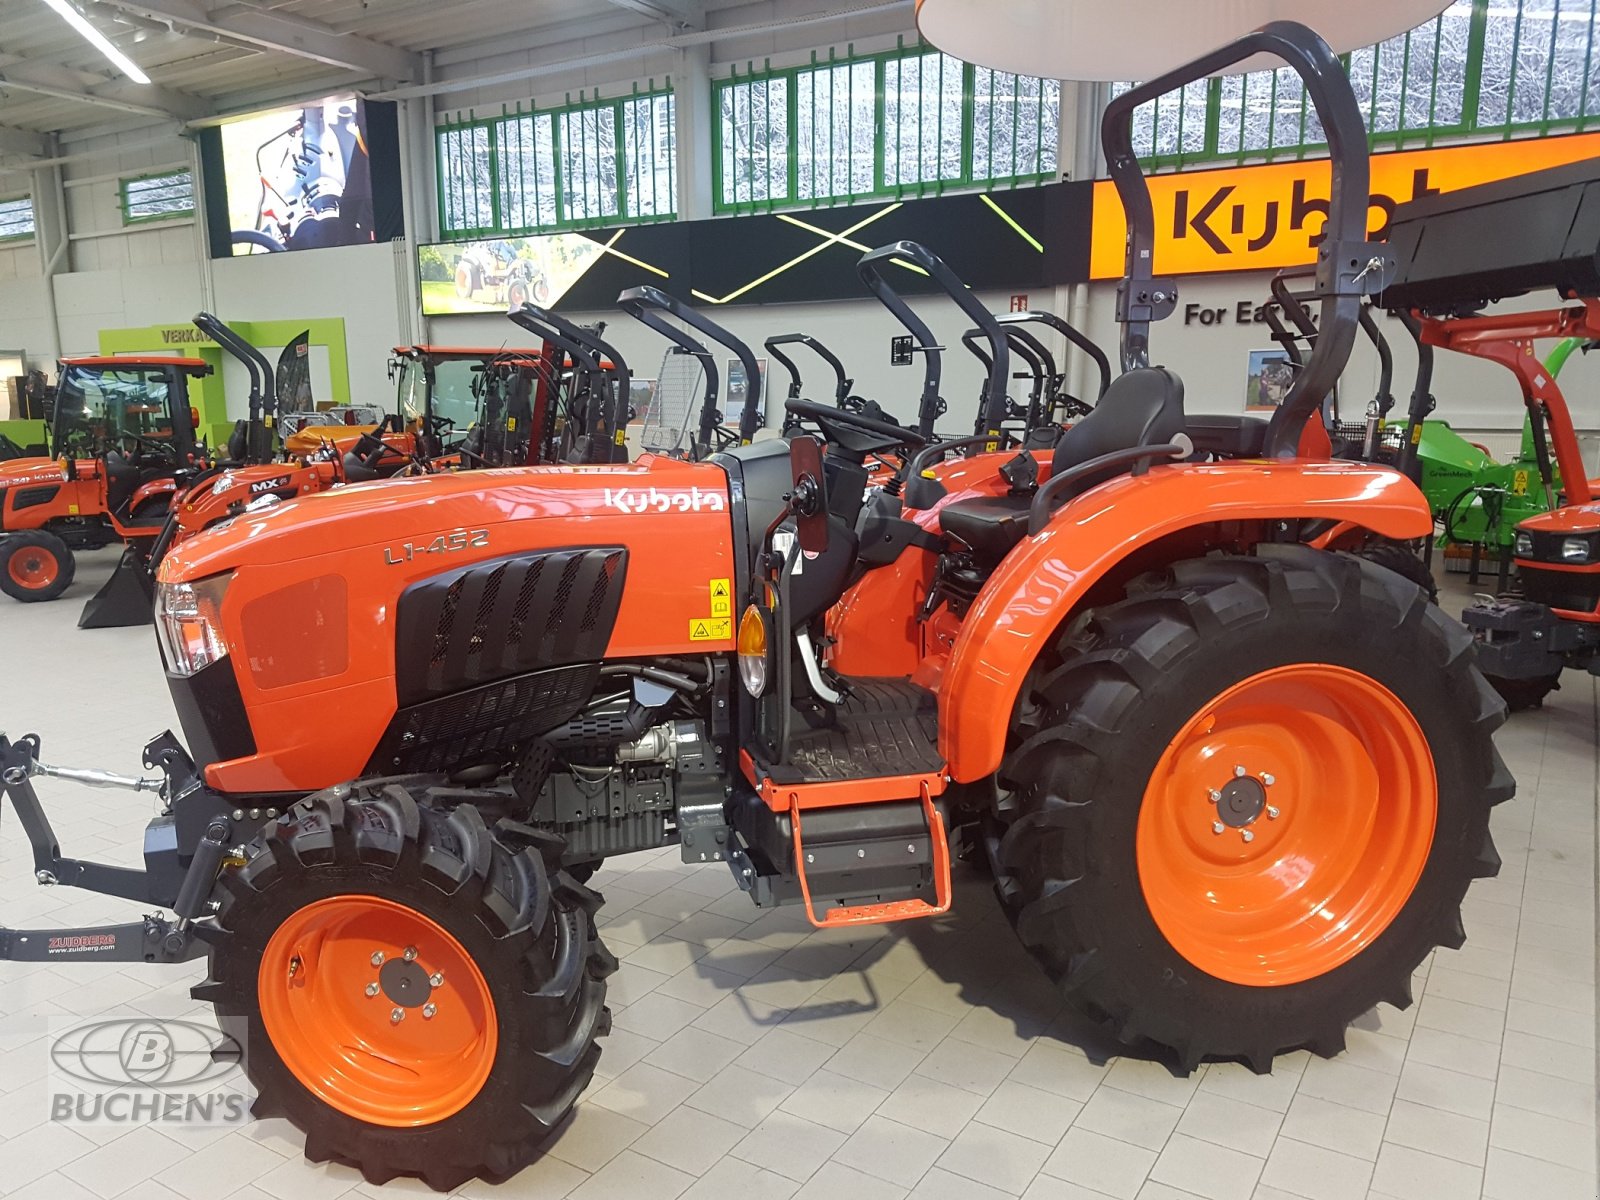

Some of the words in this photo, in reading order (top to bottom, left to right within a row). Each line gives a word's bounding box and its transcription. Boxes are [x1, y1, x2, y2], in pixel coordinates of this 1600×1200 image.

[1173, 168, 1440, 254] Kubot
[1184, 303, 1227, 325] For
[161, 329, 213, 343] VERKAU
[34, 472, 61, 480] Kubo
[251, 478, 279, 492] MX
[603, 486, 724, 513] Kubota
[384, 529, 490, 566] L1-452
[49, 934, 116, 948] ZUIDBERG
[48, 944, 115, 954] www.zuidberg.com
